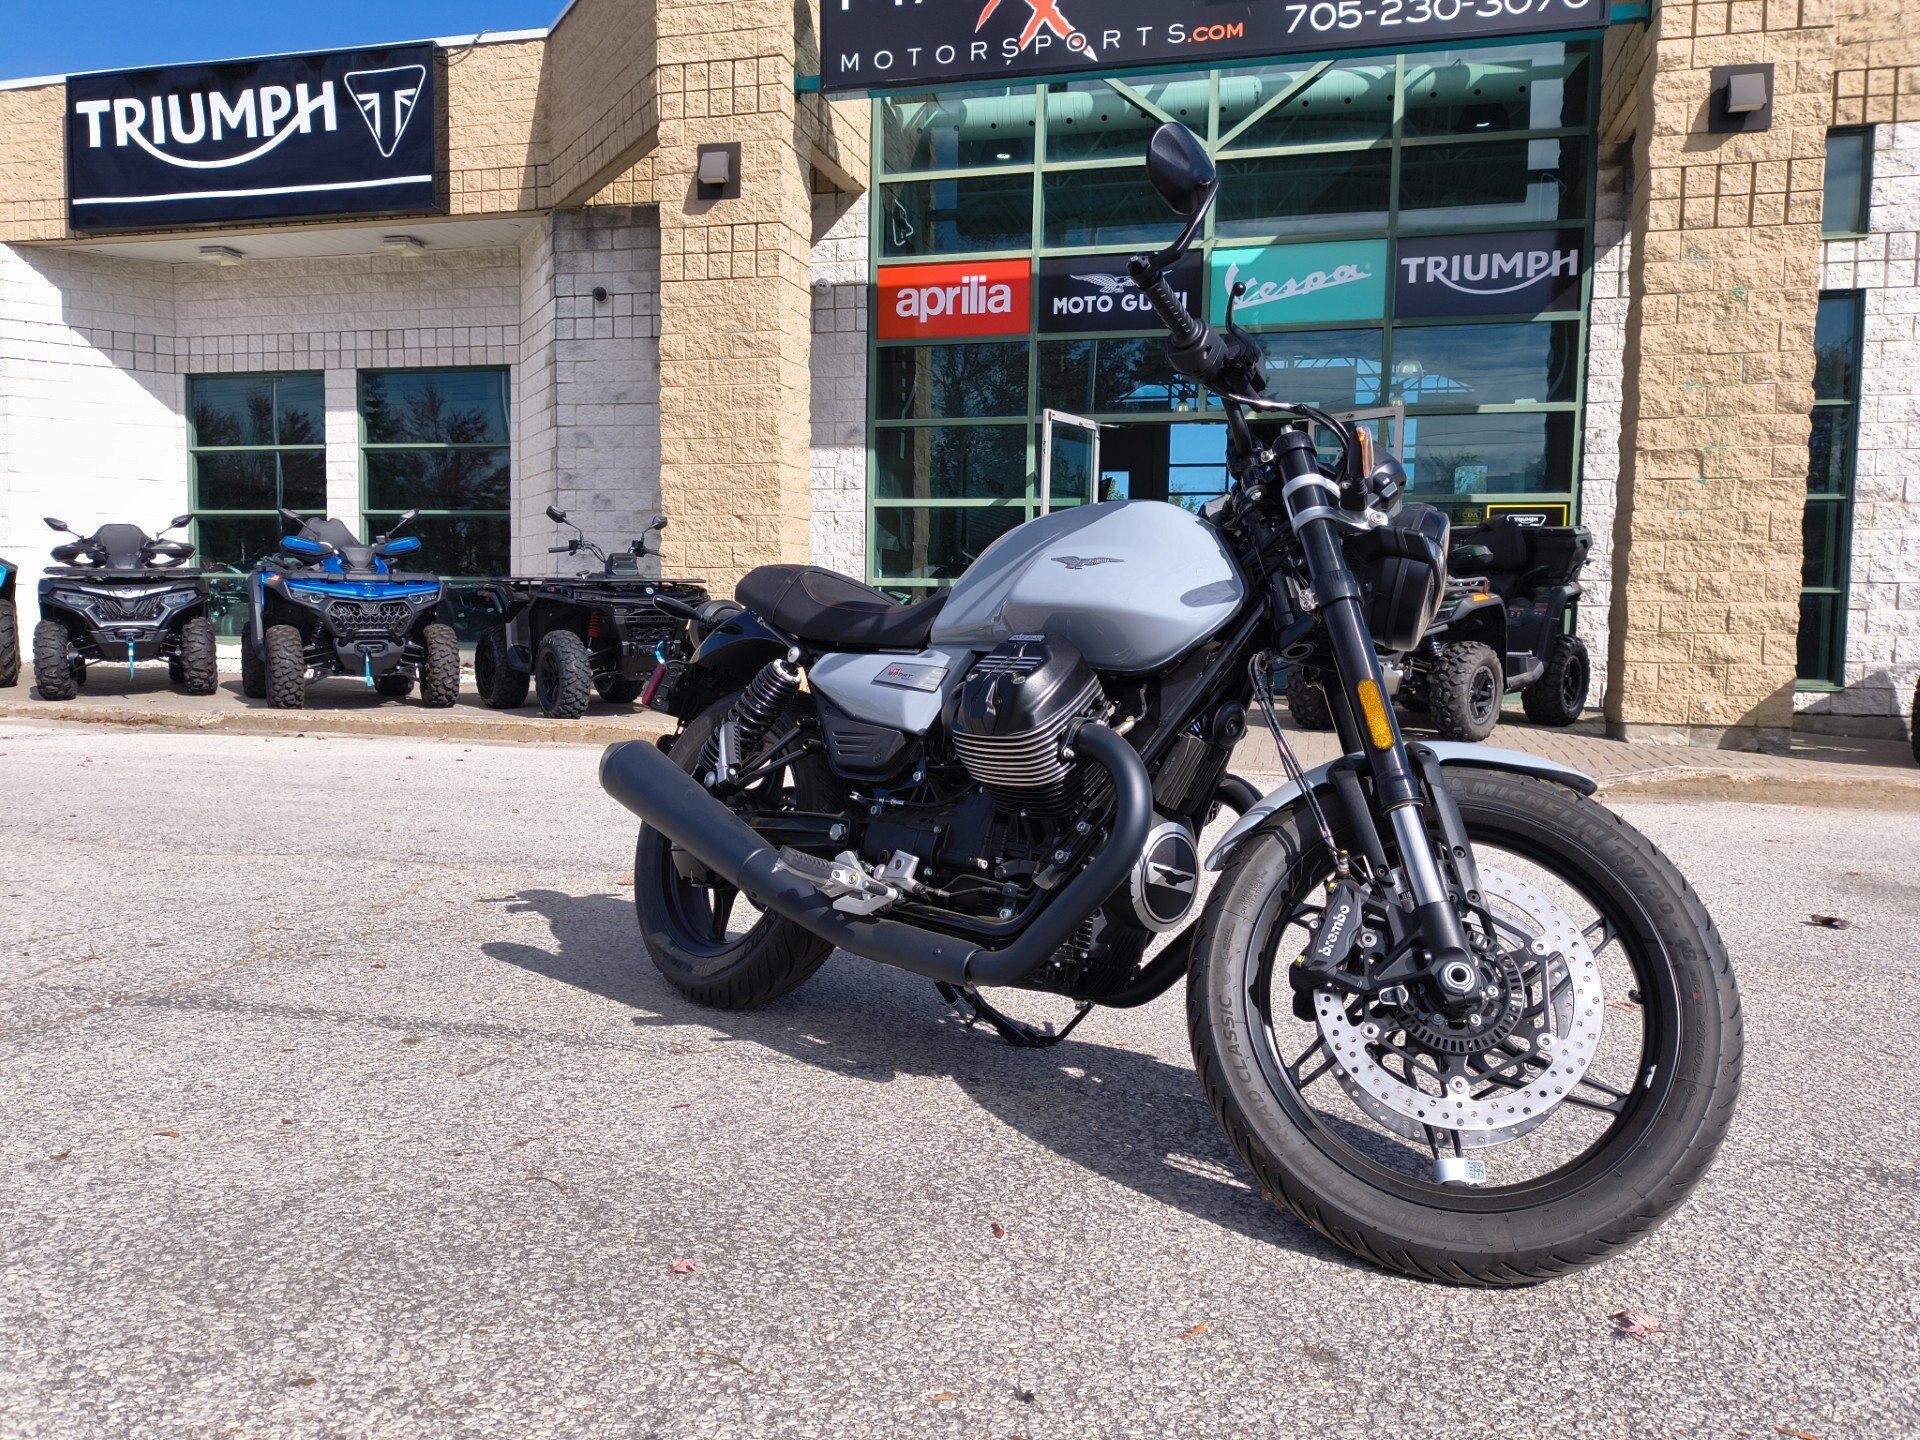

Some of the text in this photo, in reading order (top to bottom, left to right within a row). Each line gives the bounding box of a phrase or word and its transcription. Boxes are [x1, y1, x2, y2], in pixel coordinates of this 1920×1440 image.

[76, 80, 337, 169] TRIUMPH
[1224, 261, 1372, 311] Vespa
[1400, 249, 1578, 295] TRIUMPH
[895, 275, 1011, 323] aprilia
[1053, 291, 1188, 315] MOTO GUI
[1472, 781, 1612, 844] MICHELIN
[1318, 905, 1350, 957] brembo
[1219, 995, 1293, 1145] ROAD CLASSIC
